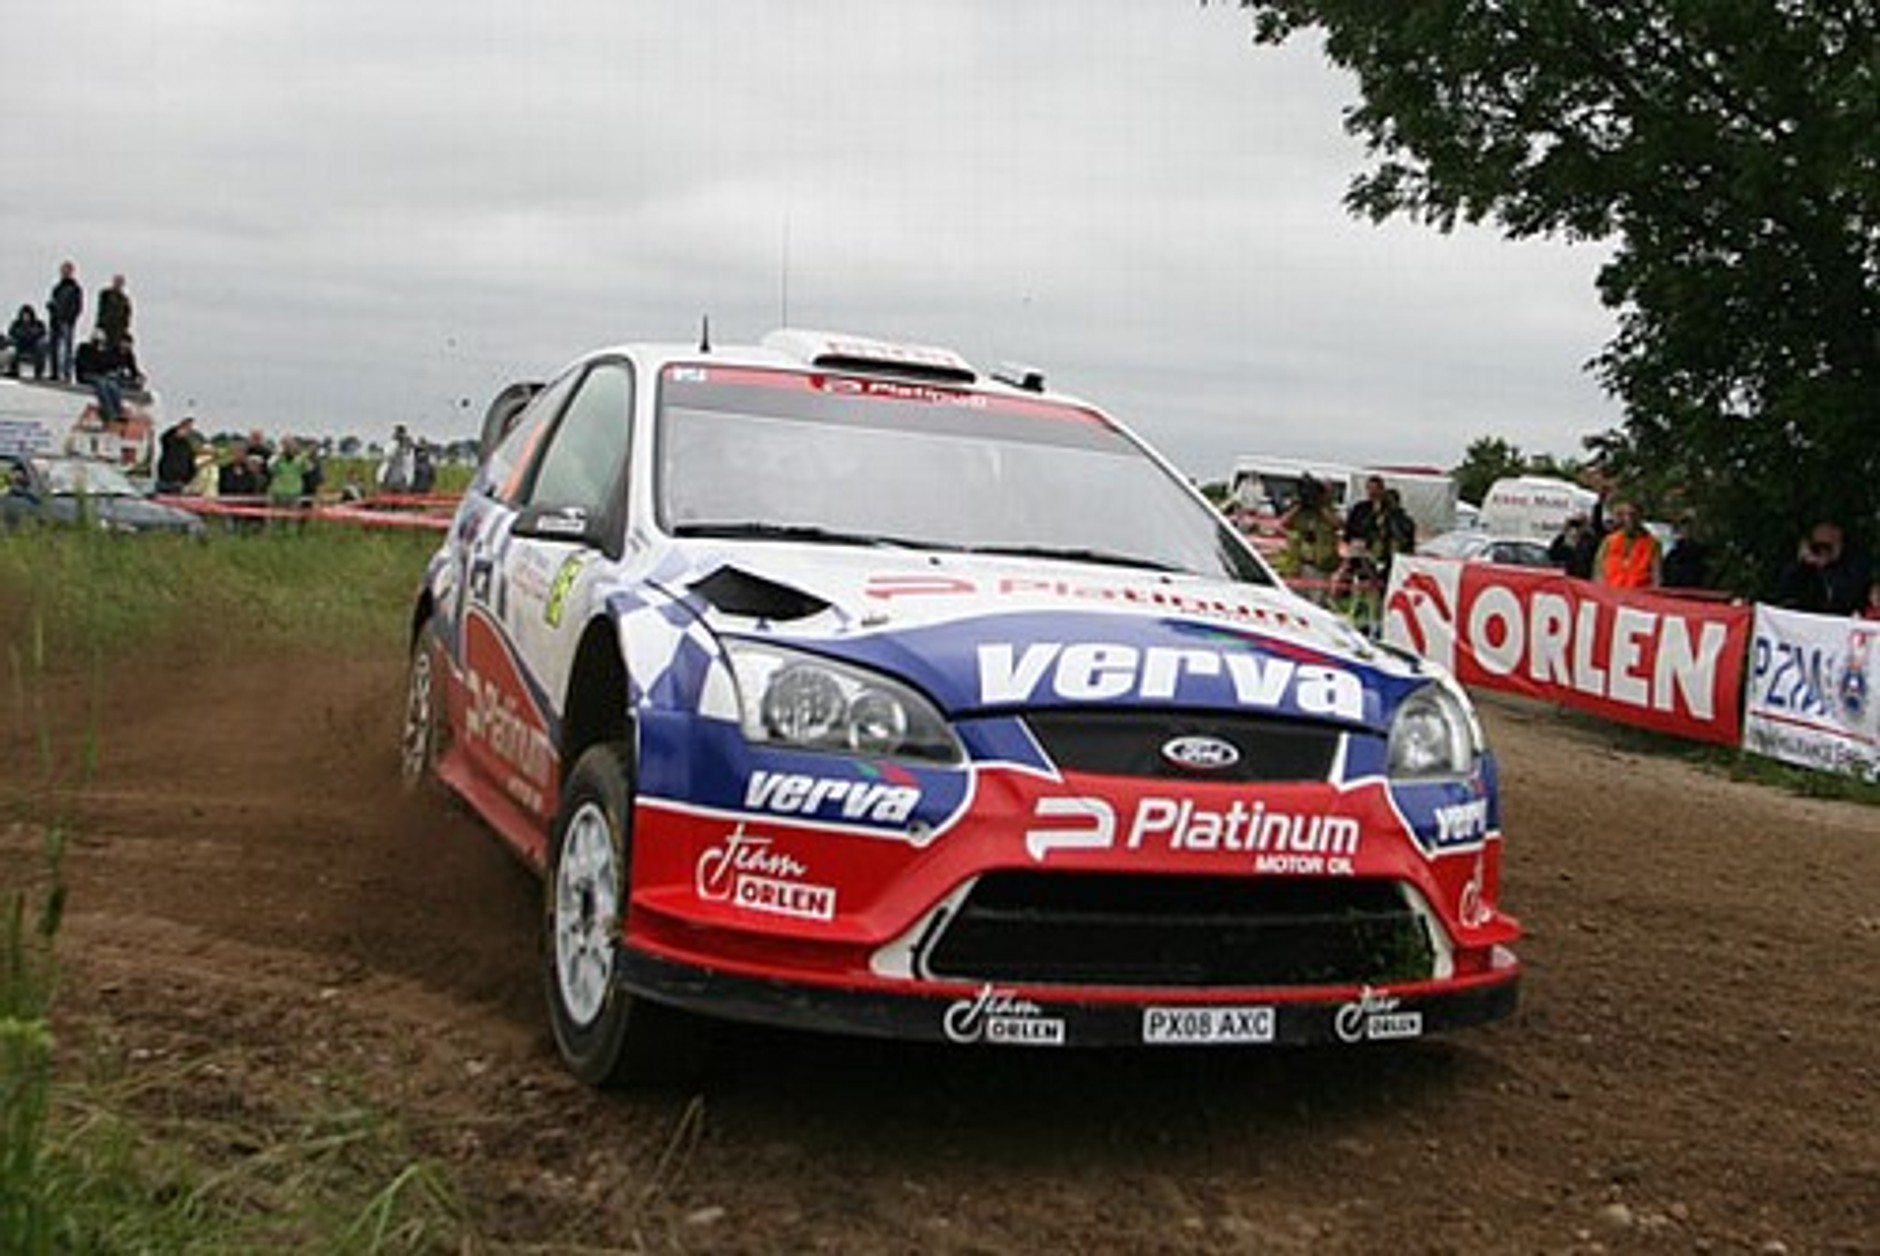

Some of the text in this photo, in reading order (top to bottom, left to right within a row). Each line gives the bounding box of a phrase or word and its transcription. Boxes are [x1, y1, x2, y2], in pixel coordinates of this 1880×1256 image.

[1468, 585, 1727, 721] ORLEN
[977, 642, 1364, 721] verva
[744, 770, 922, 823] verva
[1126, 796, 1361, 855] Platinum
[1255, 854, 1355, 876] MOTOR OIL
[739, 881, 830, 915] ORLEN
[991, 1020, 1060, 1040] ORLEN
[1148, 1010, 1270, 1037] PX08 AXC
